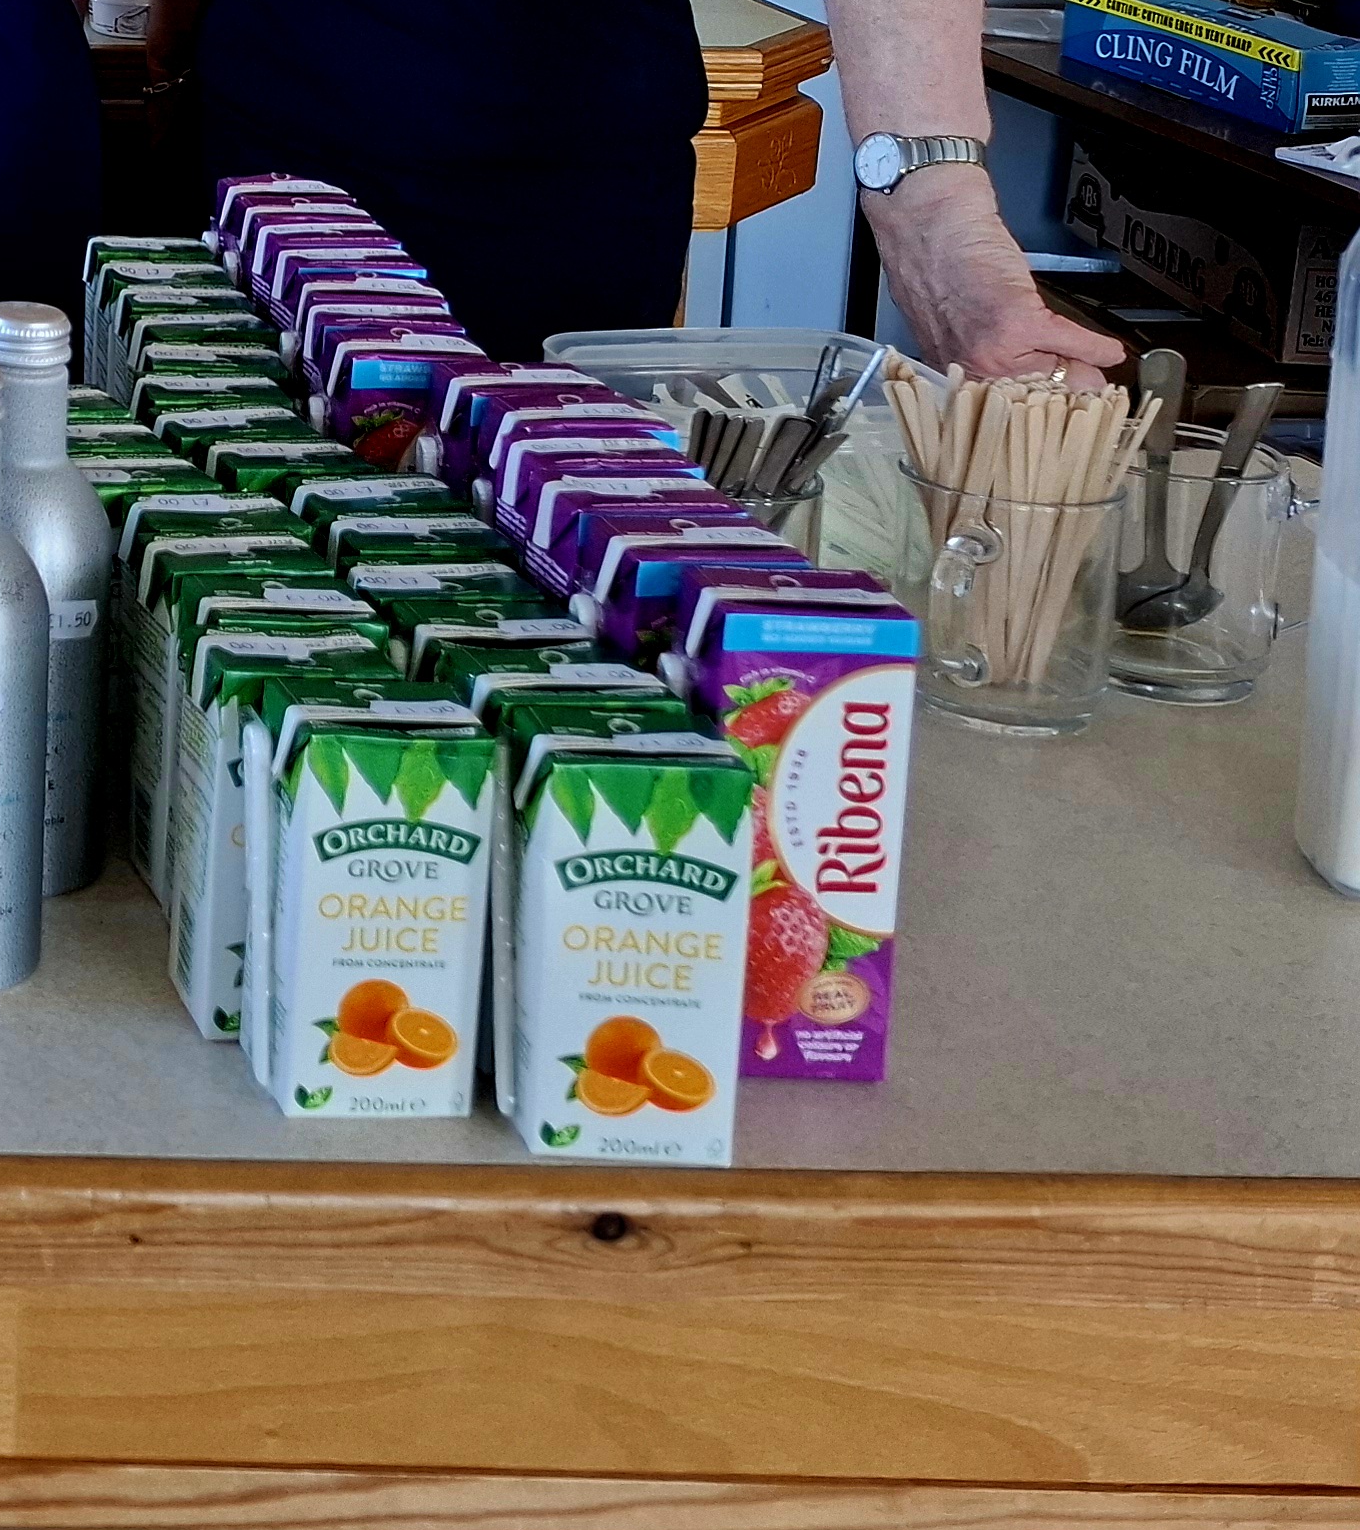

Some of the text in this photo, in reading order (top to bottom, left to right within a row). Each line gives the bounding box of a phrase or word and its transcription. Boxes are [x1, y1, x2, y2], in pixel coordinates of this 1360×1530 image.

[1141, 9, 1174, 29] CUTTING
[1175, 19, 1194, 35] EDGE
[1195, 25, 1203, 38] IS
[1204, 27, 1224, 44] VERY
[1226, 34, 1252, 52] SHARP
[1096, 33, 1240, 101] CLING FILM
[1311, 96, 1360, 107] KIRKLAN
[1122, 213, 1206, 299] ICEBERG
[1315, 275, 1338, 288] HO
[815, 701, 892, 894] Ribena
[322, 823, 470, 855] ORCHARD
[347, 859, 439, 883] GROVE
[564, 855, 727, 891] ORCHARD
[318, 893, 469, 922] ORANGE
[594, 889, 693, 916] GROVE
[341, 927, 439, 953] JUICE
[562, 924, 723, 961] ORANGE
[332, 957, 446, 969] FROM CONCENTRATE
[587, 959, 694, 991] JUICE
[578, 992, 701, 1010] FROM CONCENTRATE
[348, 1096, 404, 1113] 200ml
[597, 1137, 660, 1155] 200ml
